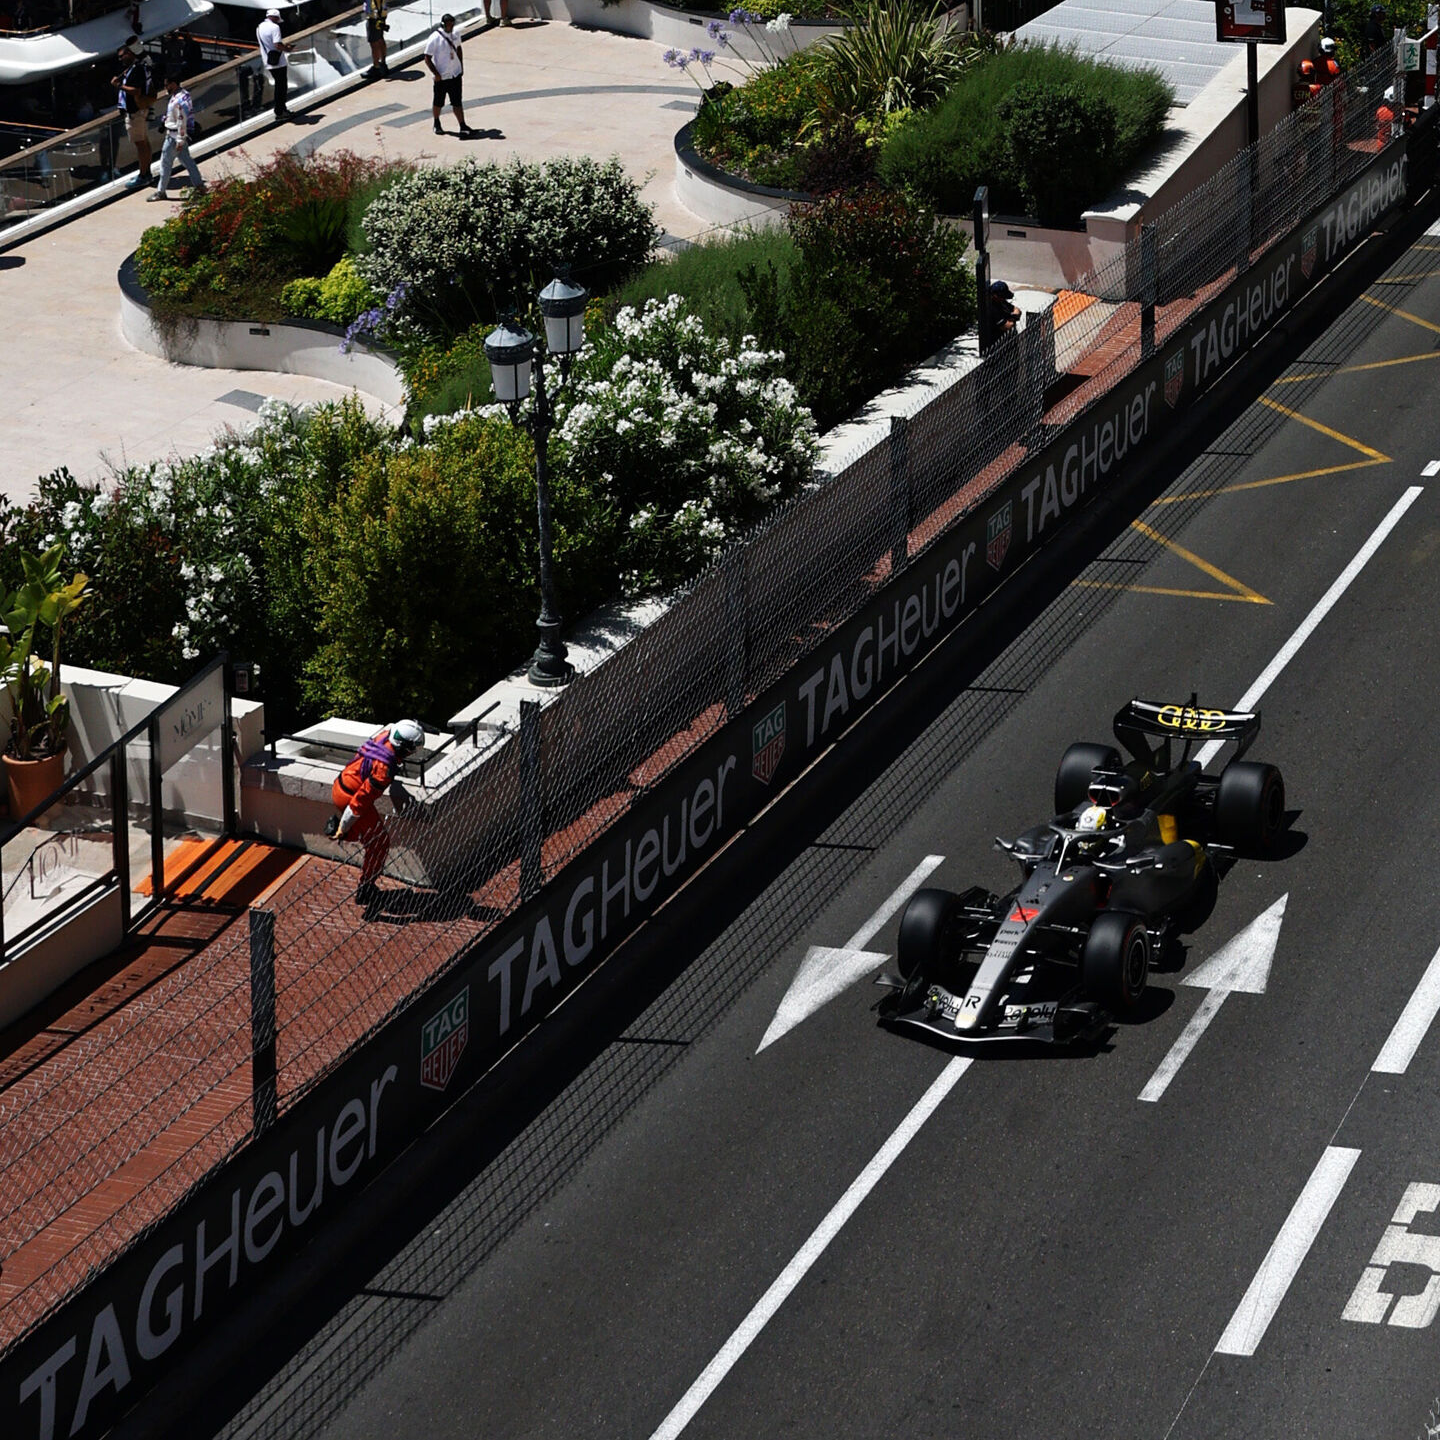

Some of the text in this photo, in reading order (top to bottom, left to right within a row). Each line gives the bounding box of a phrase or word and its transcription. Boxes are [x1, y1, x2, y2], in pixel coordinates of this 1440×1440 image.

[1166, 352, 1184, 379] TAG
[989, 506, 1010, 535] TAG
[754, 709, 784, 748] TAG
[753, 736, 784, 778] HEUER
[964, 995, 982, 1009] R
[425, 996, 466, 1049] TAG
[423, 1029, 466, 1084] HEUER
